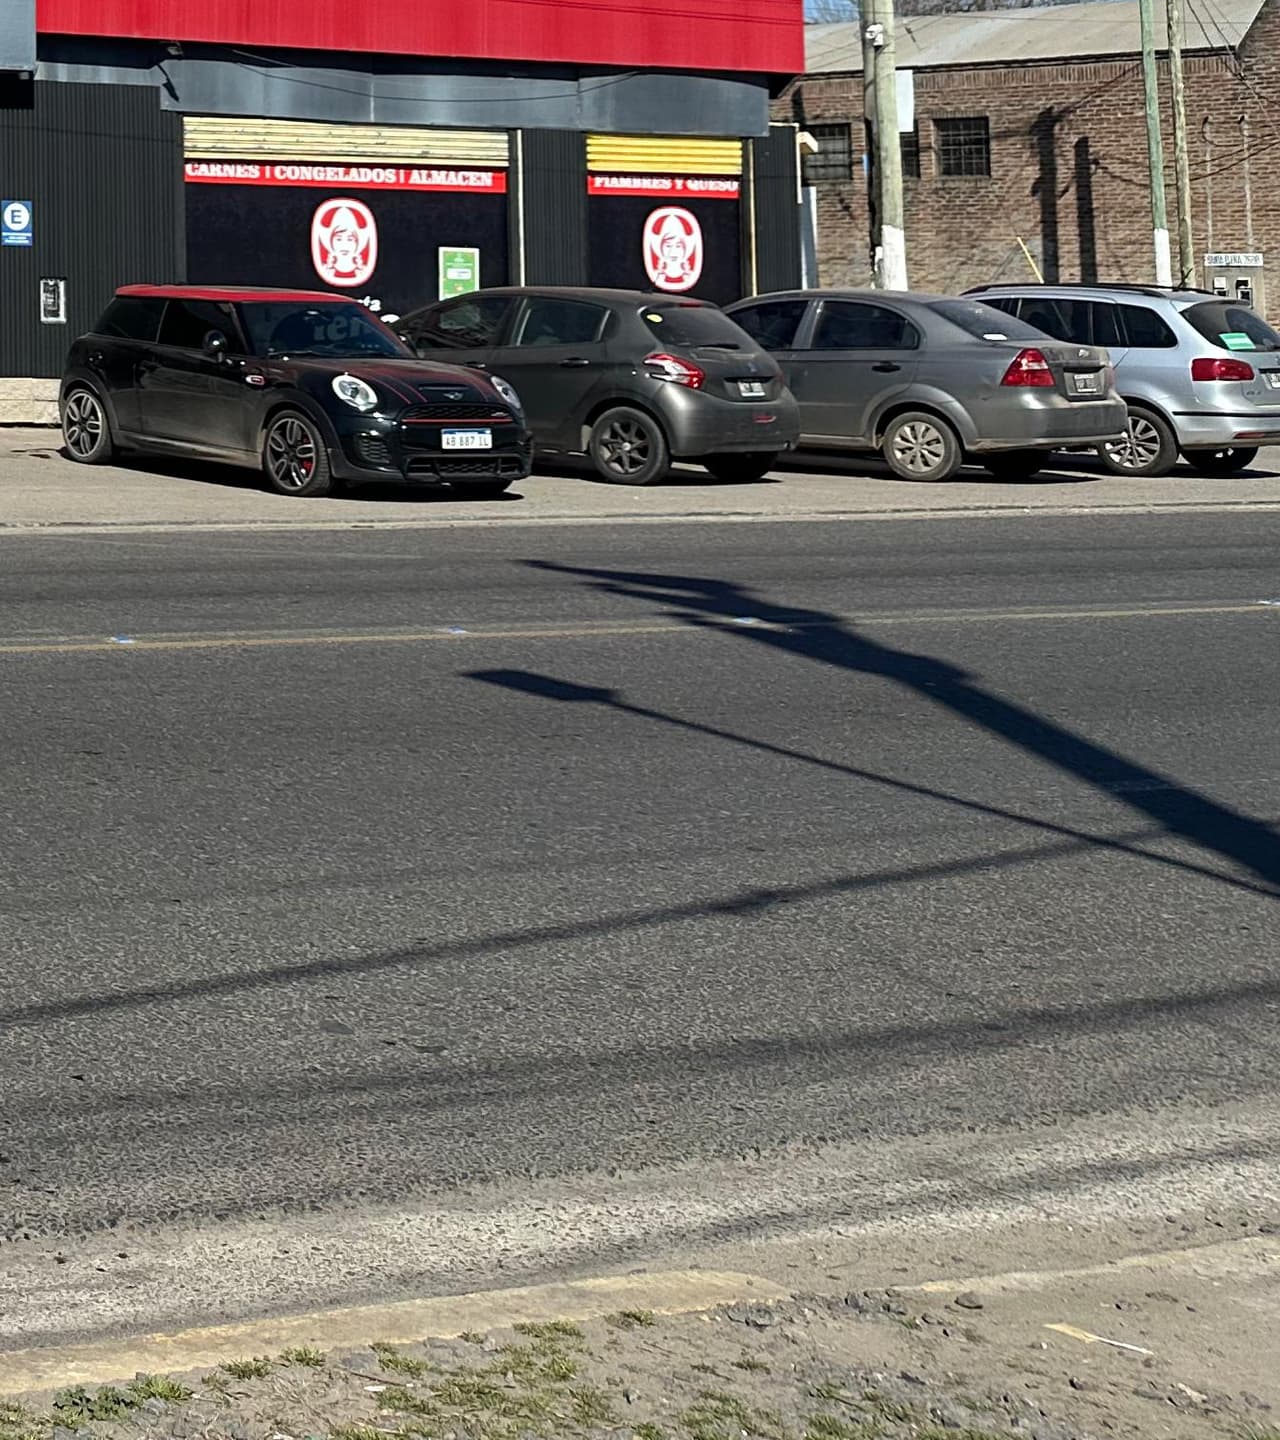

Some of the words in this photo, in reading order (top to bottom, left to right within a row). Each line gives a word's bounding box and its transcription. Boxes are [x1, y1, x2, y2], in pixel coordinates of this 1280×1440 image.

[185, 163, 260, 179] CARNES
[274, 165, 396, 183] CONGELADOS
[409, 170, 494, 186] ALMACEN
[11, 210, 22, 224] E
